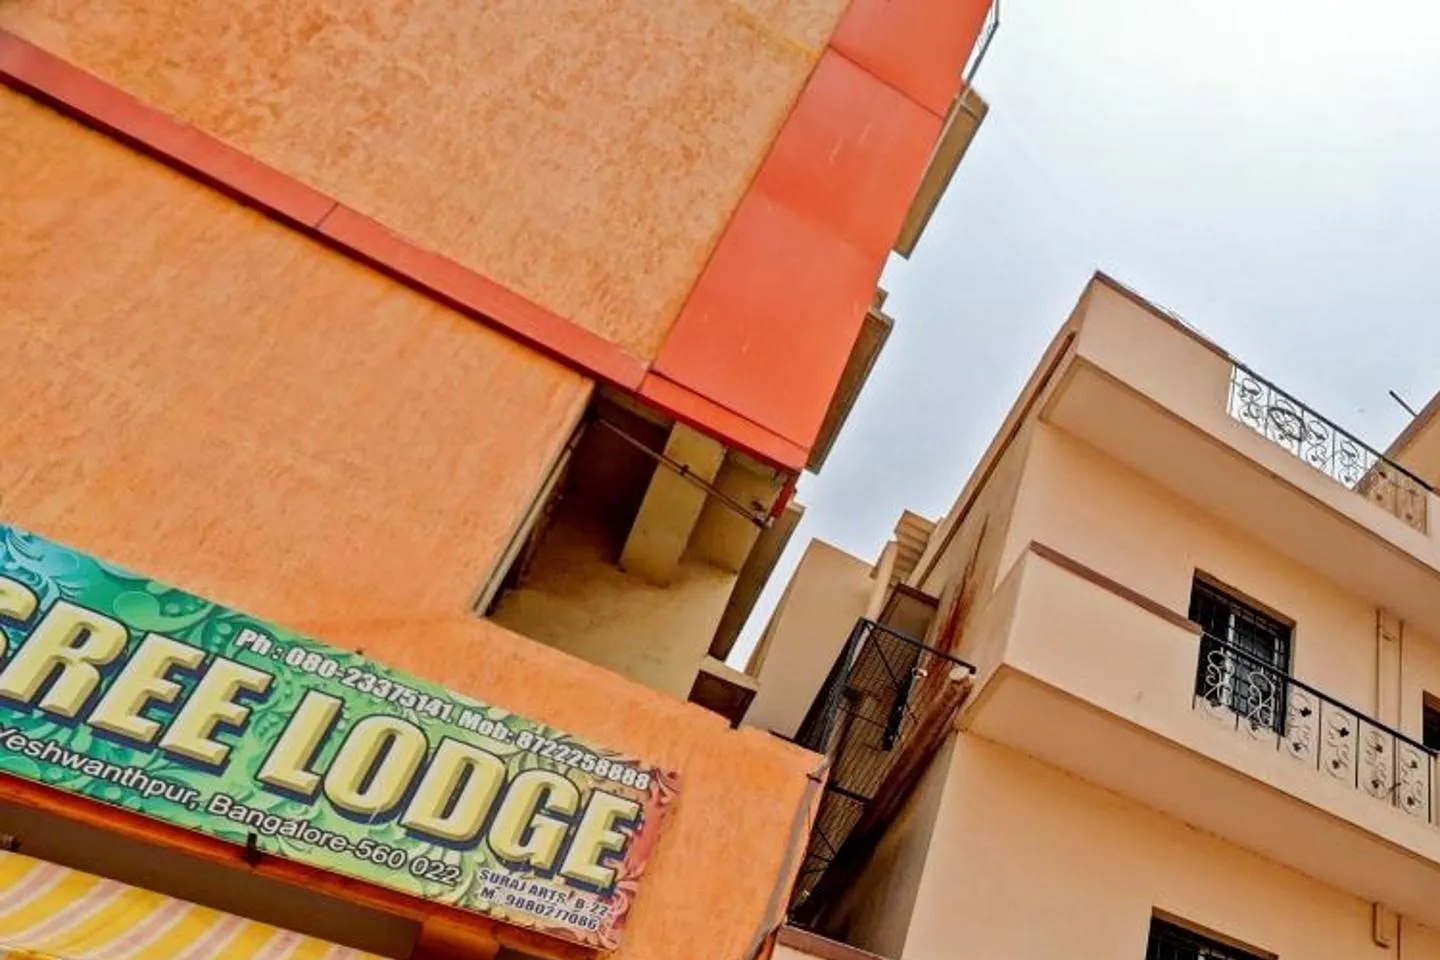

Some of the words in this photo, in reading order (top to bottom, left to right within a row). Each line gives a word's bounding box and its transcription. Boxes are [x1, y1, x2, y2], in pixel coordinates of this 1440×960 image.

[458, 709, 514, 743] Mob:
[256, 688, 642, 892] LODGE
[207, 794, 405, 869] Bangalore-560
[411, 856, 459, 886] 022
[479, 869, 526, 891] SURAJ
